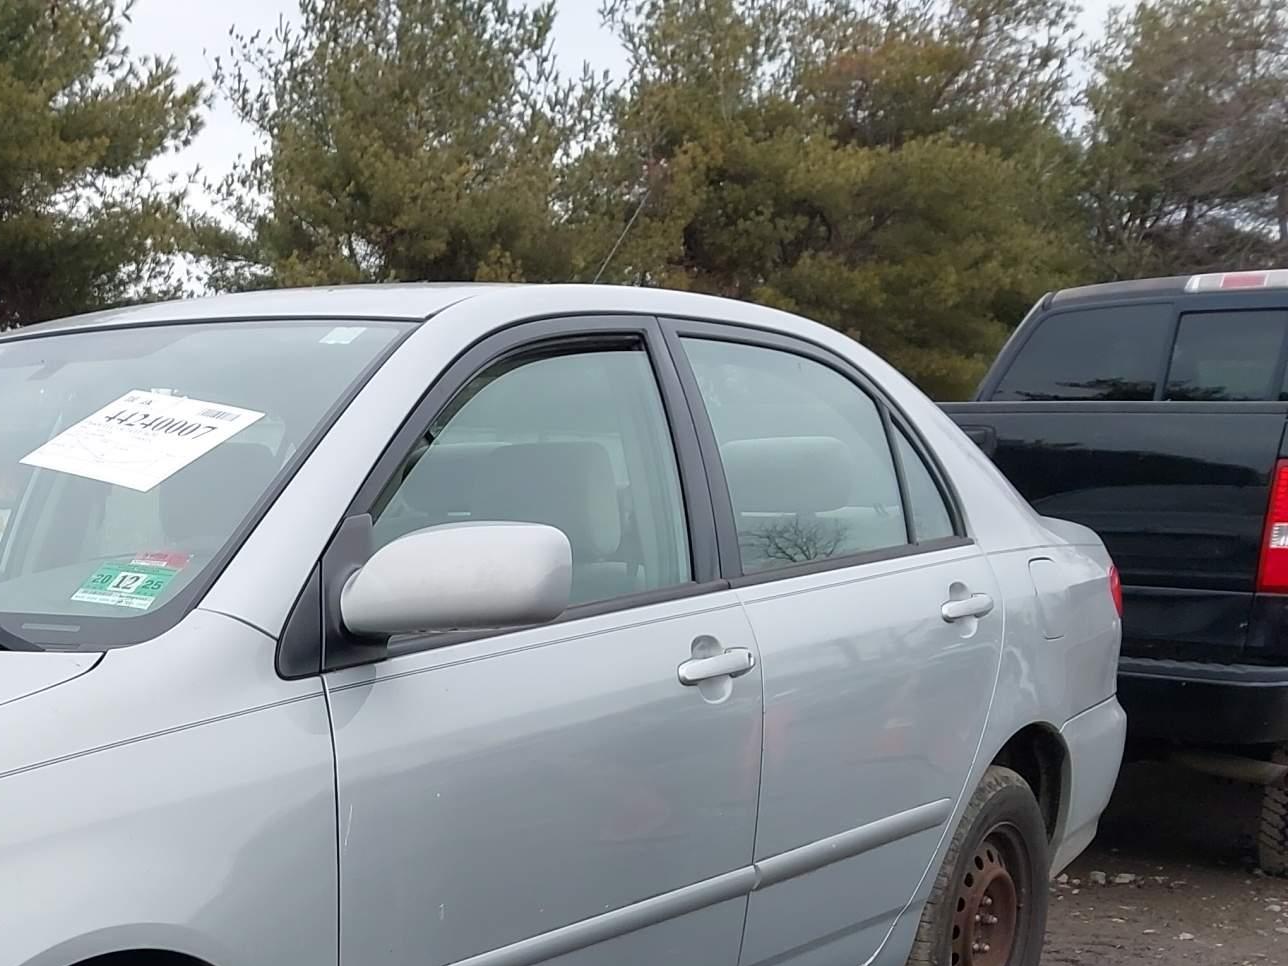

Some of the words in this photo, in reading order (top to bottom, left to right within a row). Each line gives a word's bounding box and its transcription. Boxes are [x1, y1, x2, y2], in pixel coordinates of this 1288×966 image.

[104, 409, 219, 440] 44240007
[92, 574, 112, 584] 20
[111, 573, 141, 590] 12
[142, 579, 164, 590] 25
